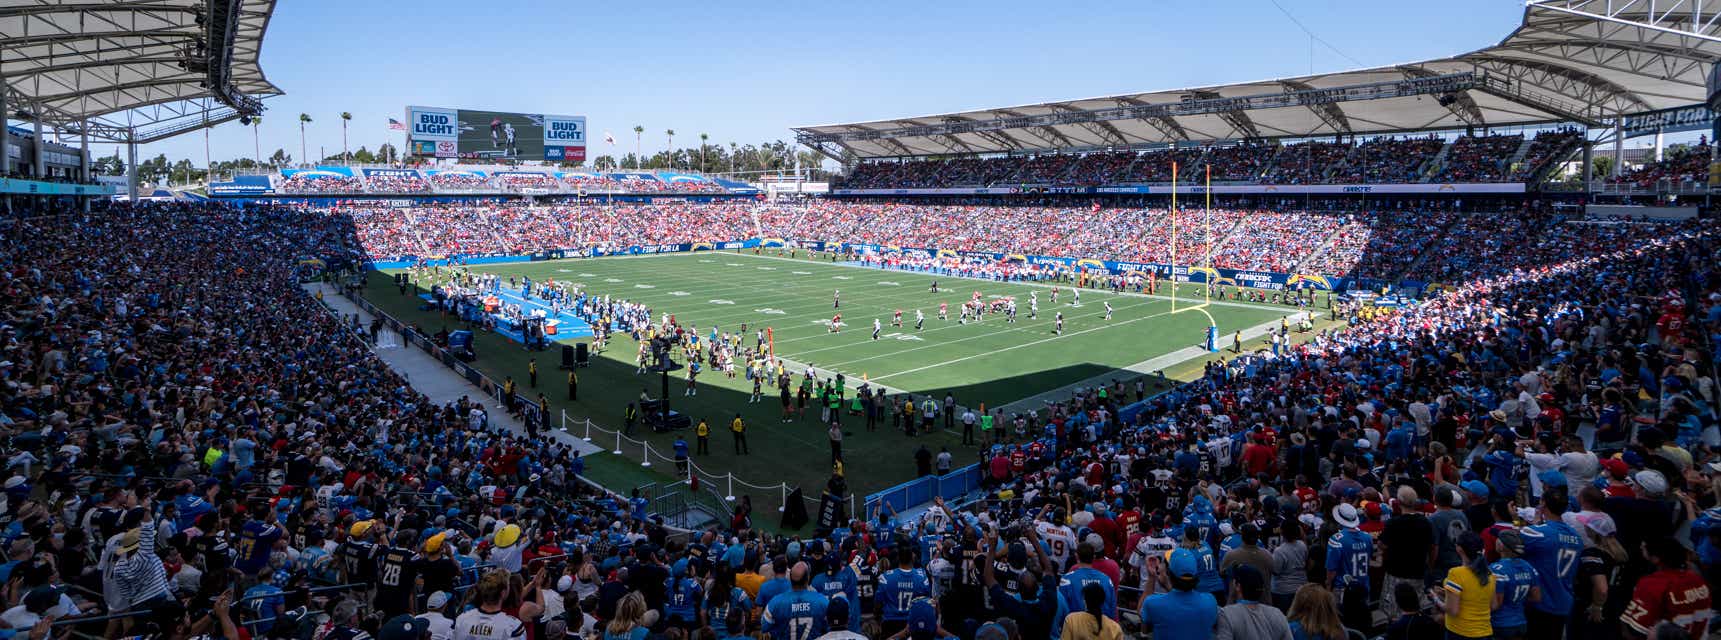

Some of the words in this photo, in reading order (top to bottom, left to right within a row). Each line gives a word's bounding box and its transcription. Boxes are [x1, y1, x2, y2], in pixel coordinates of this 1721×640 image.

[421, 114, 448, 125] BUD
[1632, 110, 1674, 131] FIGHT
[1676, 107, 1707, 126] FOR
[415, 123, 454, 134] LIGHT
[552, 122, 577, 131] BUD
[547, 130, 582, 140] LIGHT
[1116, 263, 1141, 272] FIGHT
[1253, 281, 1271, 289] FIGHT
[1166, 496, 1181, 511] 85
[1559, 533, 1580, 545] RIVERS
[1047, 540, 1065, 557] 19
[1352, 552, 1369, 577] 13
[1557, 548, 1577, 578] 17
[382, 562, 402, 586] 28
[1512, 584, 1531, 603] 17
[791, 602, 812, 613] RIVERS
[898, 591, 914, 612] 17
[469, 625, 493, 636] ALLEN
[788, 616, 814, 640] 17
